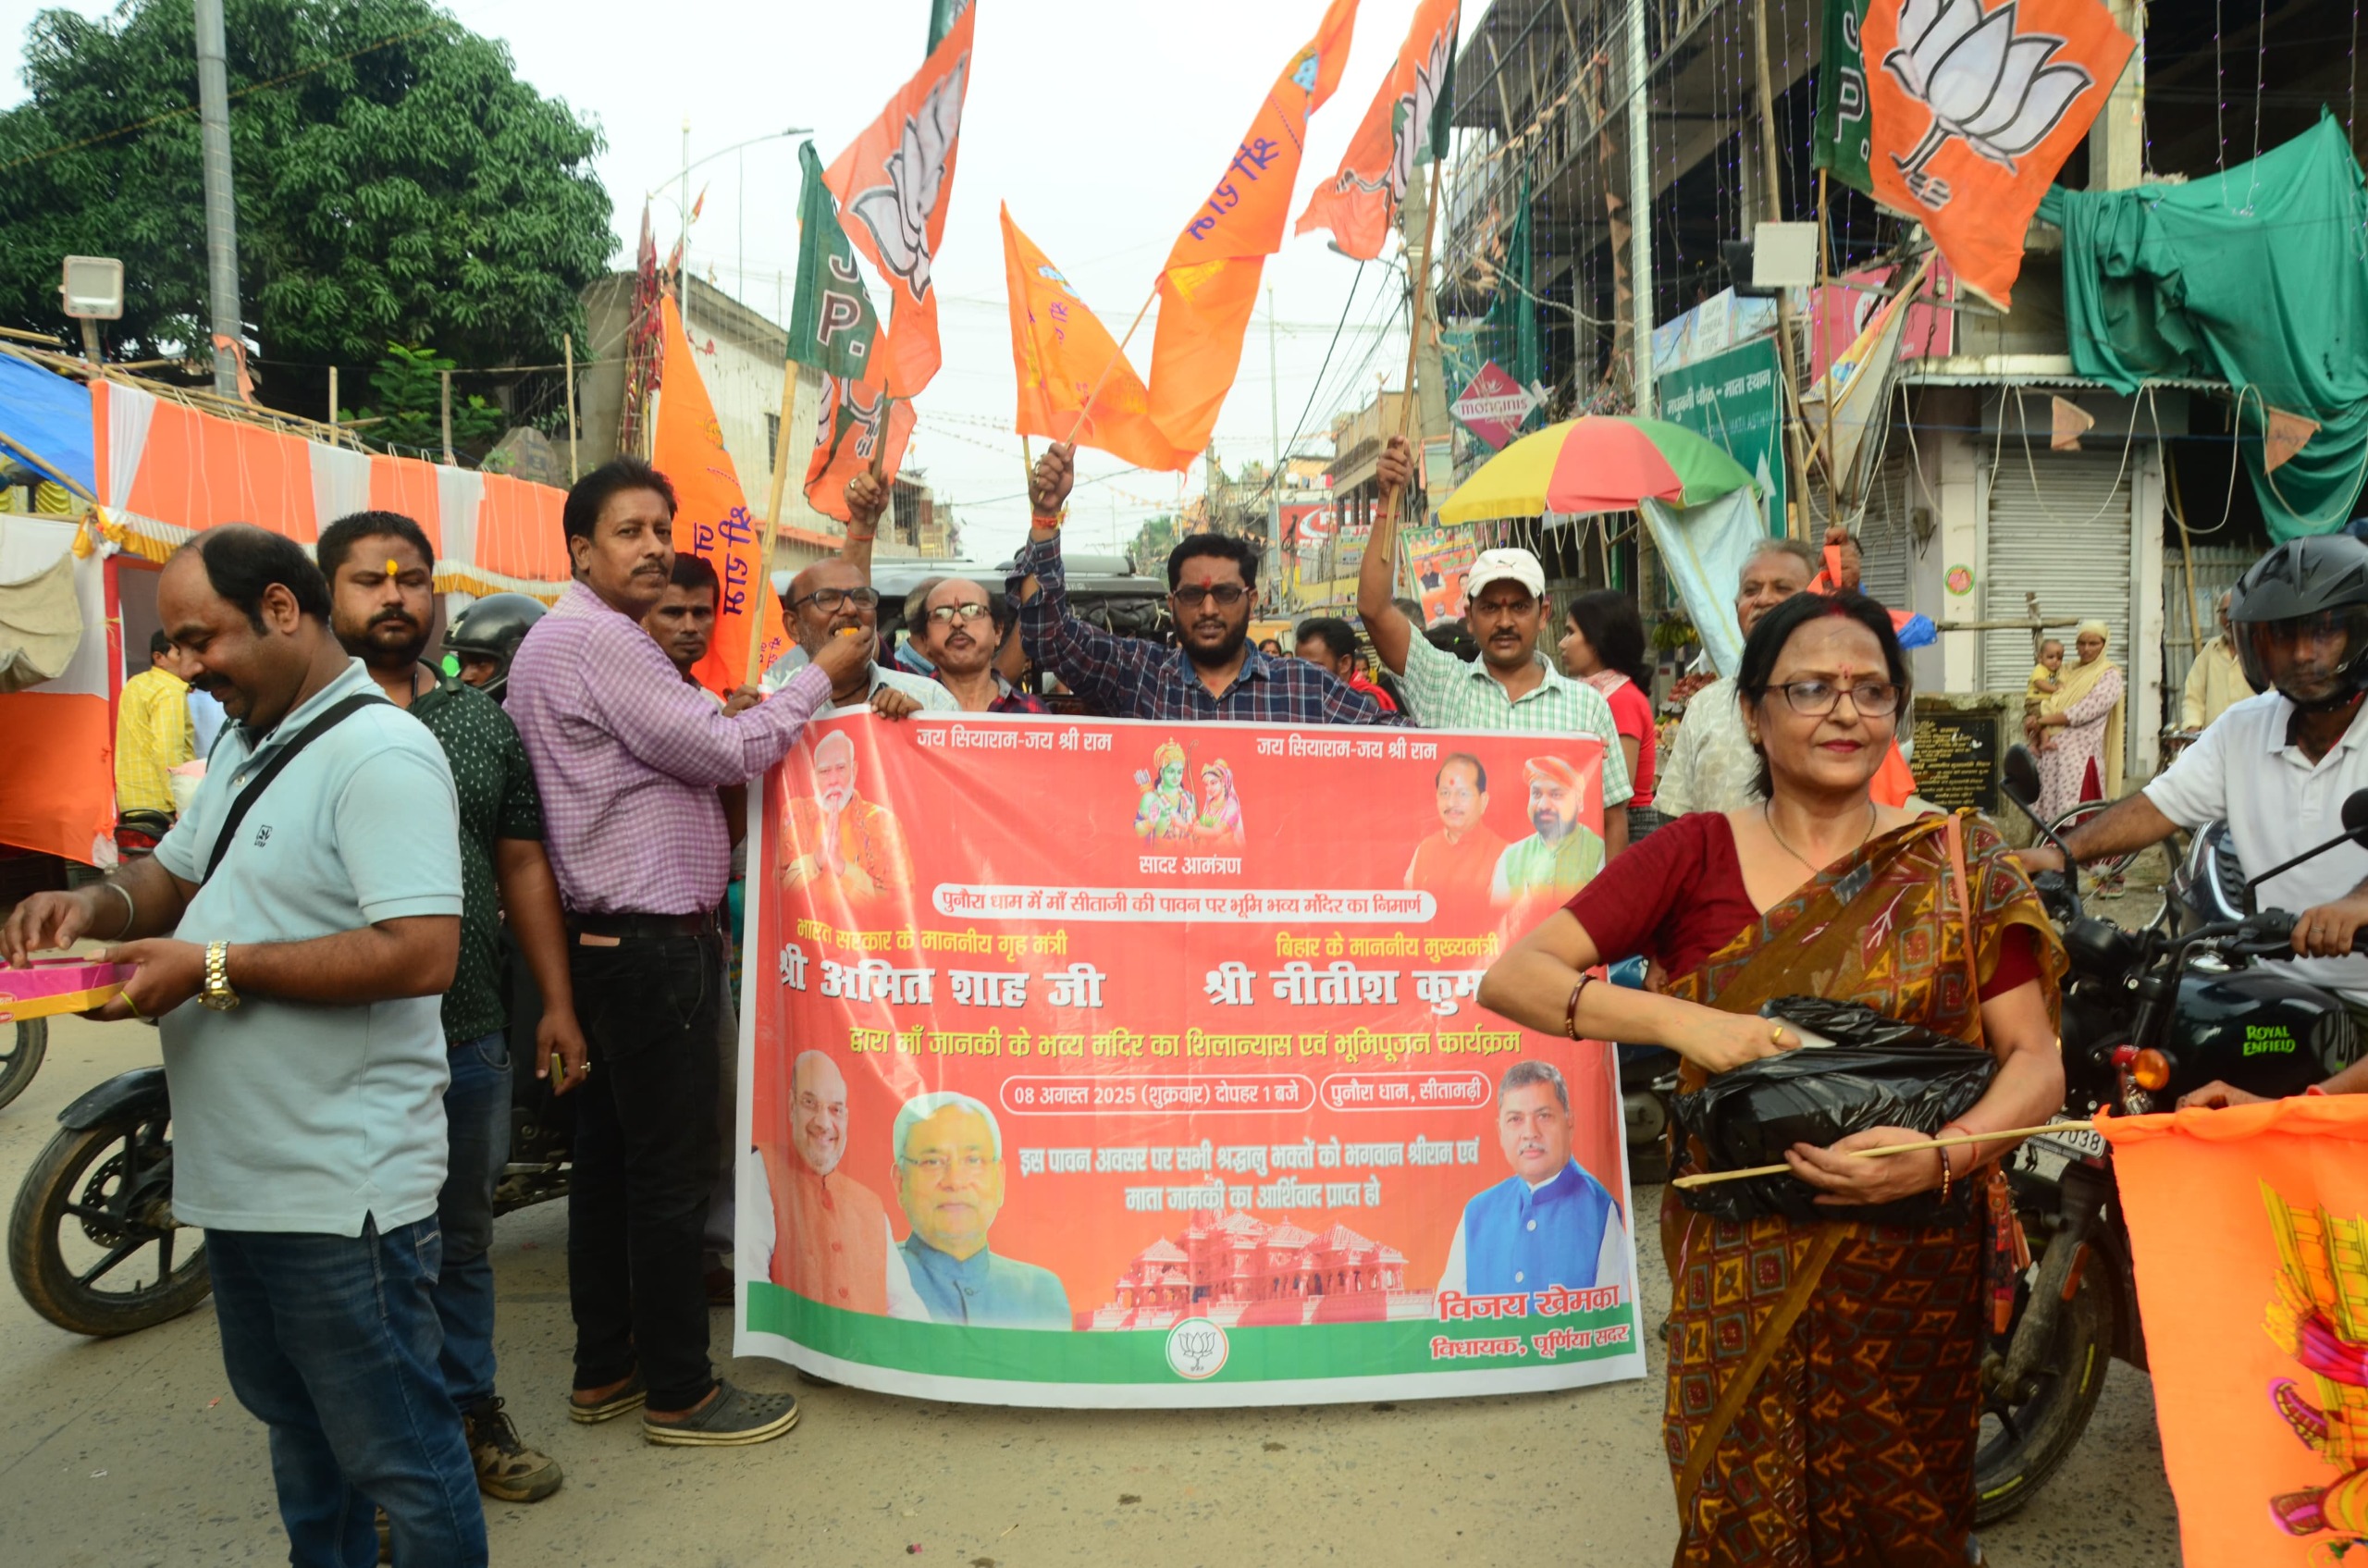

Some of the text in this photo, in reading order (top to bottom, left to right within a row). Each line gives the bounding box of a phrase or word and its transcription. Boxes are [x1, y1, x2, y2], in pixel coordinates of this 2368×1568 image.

[1723, 377, 1745, 398] माता
[1746, 368, 1771, 393] स्थान
[917, 724, 1112, 751] जय सियाराम-जय श्री राम
[1257, 733, 1437, 760] जय सियाराम-जय श्री राम
[1139, 853, 1241, 874] सादर आमंत्रण
[943, 888, 986, 912] पुनौरा
[990, 893, 1023, 909] धाम
[1027, 890, 1044, 909] में
[1070, 891, 1128, 912] सीताजी
[1132, 891, 1155, 912] की
[1159, 895, 1201, 913] पावन
[1205, 896, 1227, 913] पर
[1230, 893, 1263, 919] भूमि
[1266, 896, 1300, 914] भव्य
[1347, 897, 1369, 913] का
[796, 918, 1068, 963] भारत सरकार के माननीय गृह मंत्री
[1276, 931, 1499, 963] बिहार के माननीय मुख्यमंत्री
[779, 943, 1106, 1009] श्री अमित शाह जी
[1203, 960, 1257, 1006] श्री
[1268, 960, 1400, 1006] नीतीश
[849, 1023, 1522, 1064] द्वारा माँ जानकी के भव्य मंदिर का शिलान्यास एवं भूमिपूजन कार्यक्रम
[2243, 1039, 2296, 1056] ENFIELD
[2246, 1025, 2290, 1041] ROYAL
[1014, 1080, 1299, 1106] 08 अगस्त 2025 (शुक्रवार) दोपहर 1 बजे
[1330, 1080, 1374, 1106] पुनौरा
[1419, 1077, 1482, 1103] सीतामढ़ी
[1018, 1147, 1045, 1178] इस
[1047, 1147, 1092, 1173] पावन
[1095, 1146, 1148, 1173] अवसर
[1151, 1145, 1174, 1171] पर
[1176, 1139, 1213, 1171] सभी
[1317, 1136, 1341, 1167] को
[1344, 1142, 1404, 1167] भगवान
[1408, 1134, 1454, 1166] श्रीराम
[1456, 1135, 1480, 1165] एवं
[1125, 1185, 1164, 1211] माता
[1166, 1178, 1226, 1211] जानकी
[1228, 1184, 1253, 1209] का
[1326, 1181, 1361, 1208] प्राप्त
[1363, 1174, 1381, 1206] हो
[1437, 1284, 1620, 1322] विजय खेमका
[1431, 1324, 1631, 1360] विधायक, पूर्णिया सदर
